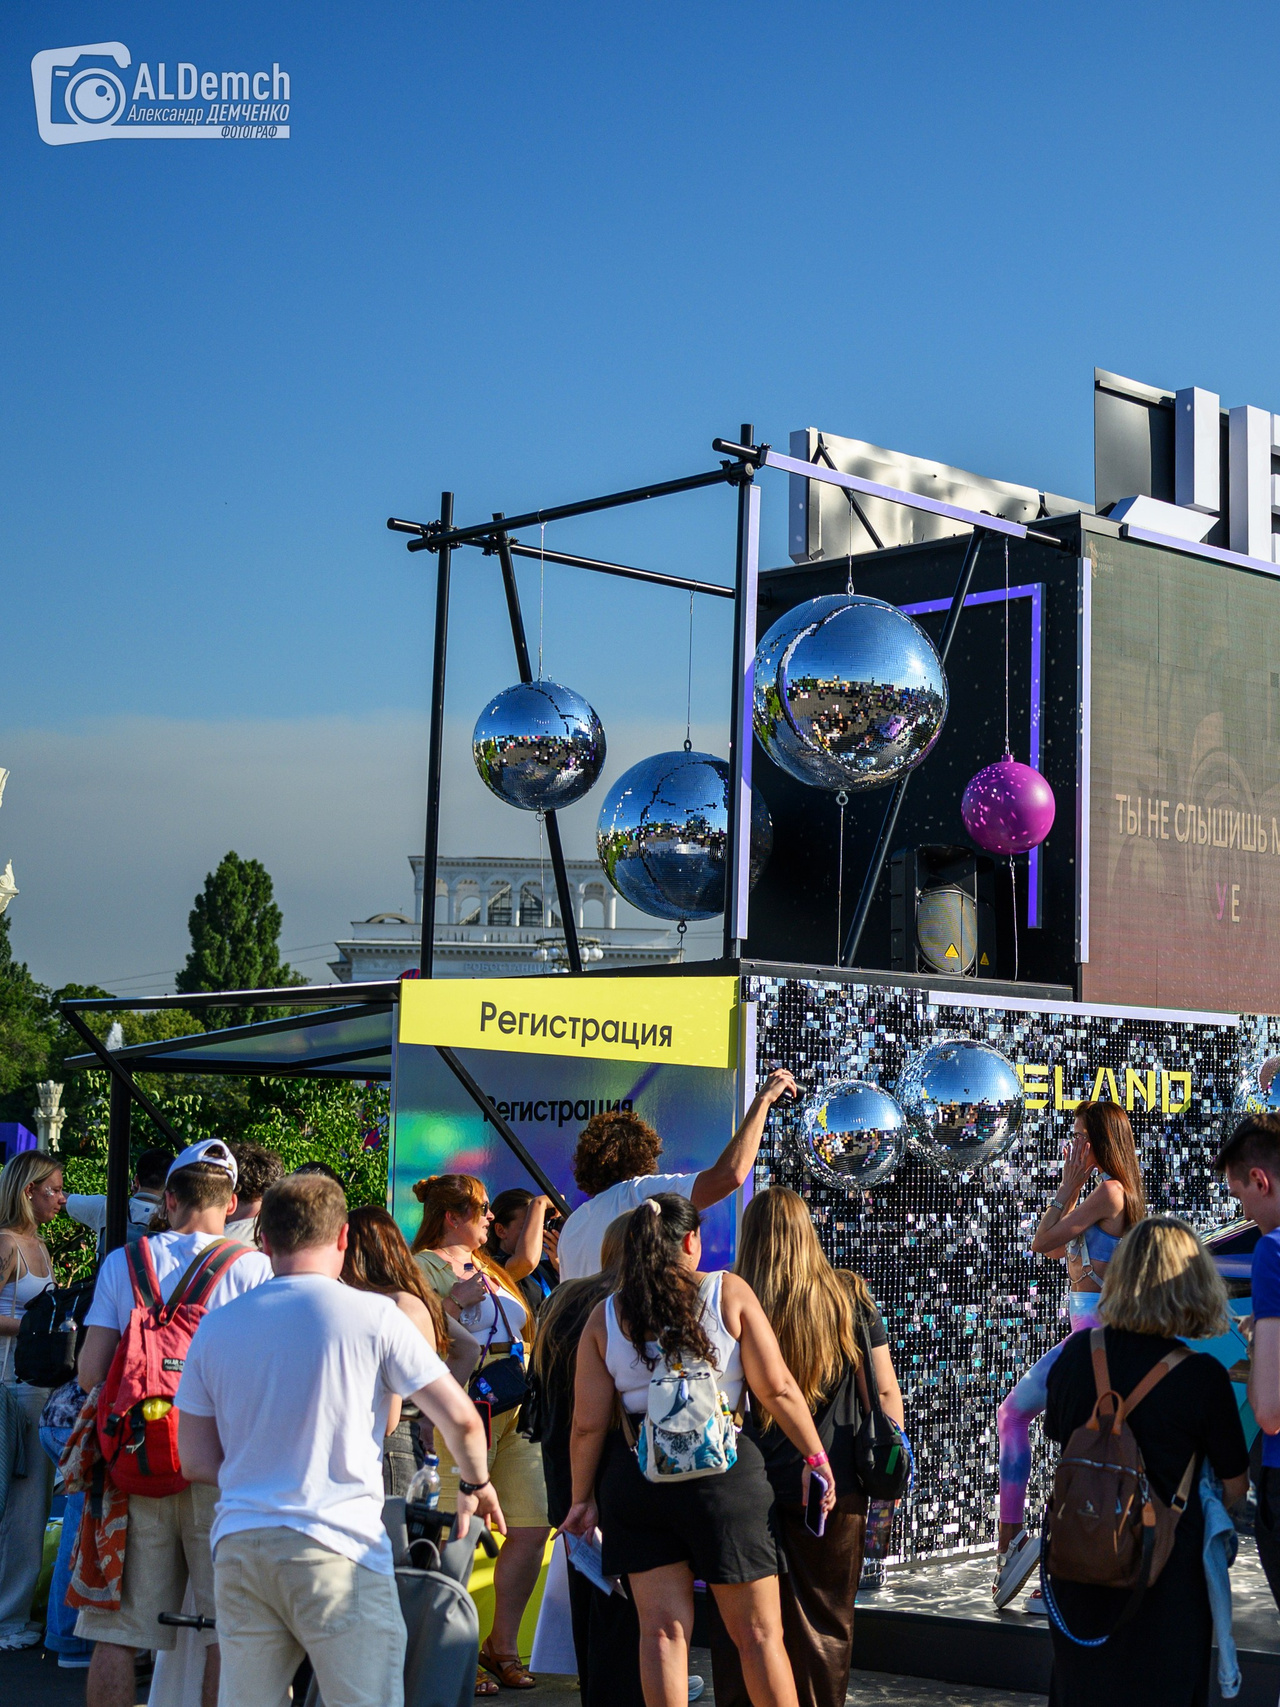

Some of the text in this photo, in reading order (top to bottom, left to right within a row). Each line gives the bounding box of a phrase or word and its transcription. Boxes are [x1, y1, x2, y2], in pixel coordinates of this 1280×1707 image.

[1115, 794, 1142, 836] ТЫ
[1147, 798, 1170, 840] НЕ
[1174, 802, 1268, 853] СЛЫШИШЬ
[480, 1001, 673, 1049] Регистрация
[1016, 1064, 1191, 1113] ELAND
